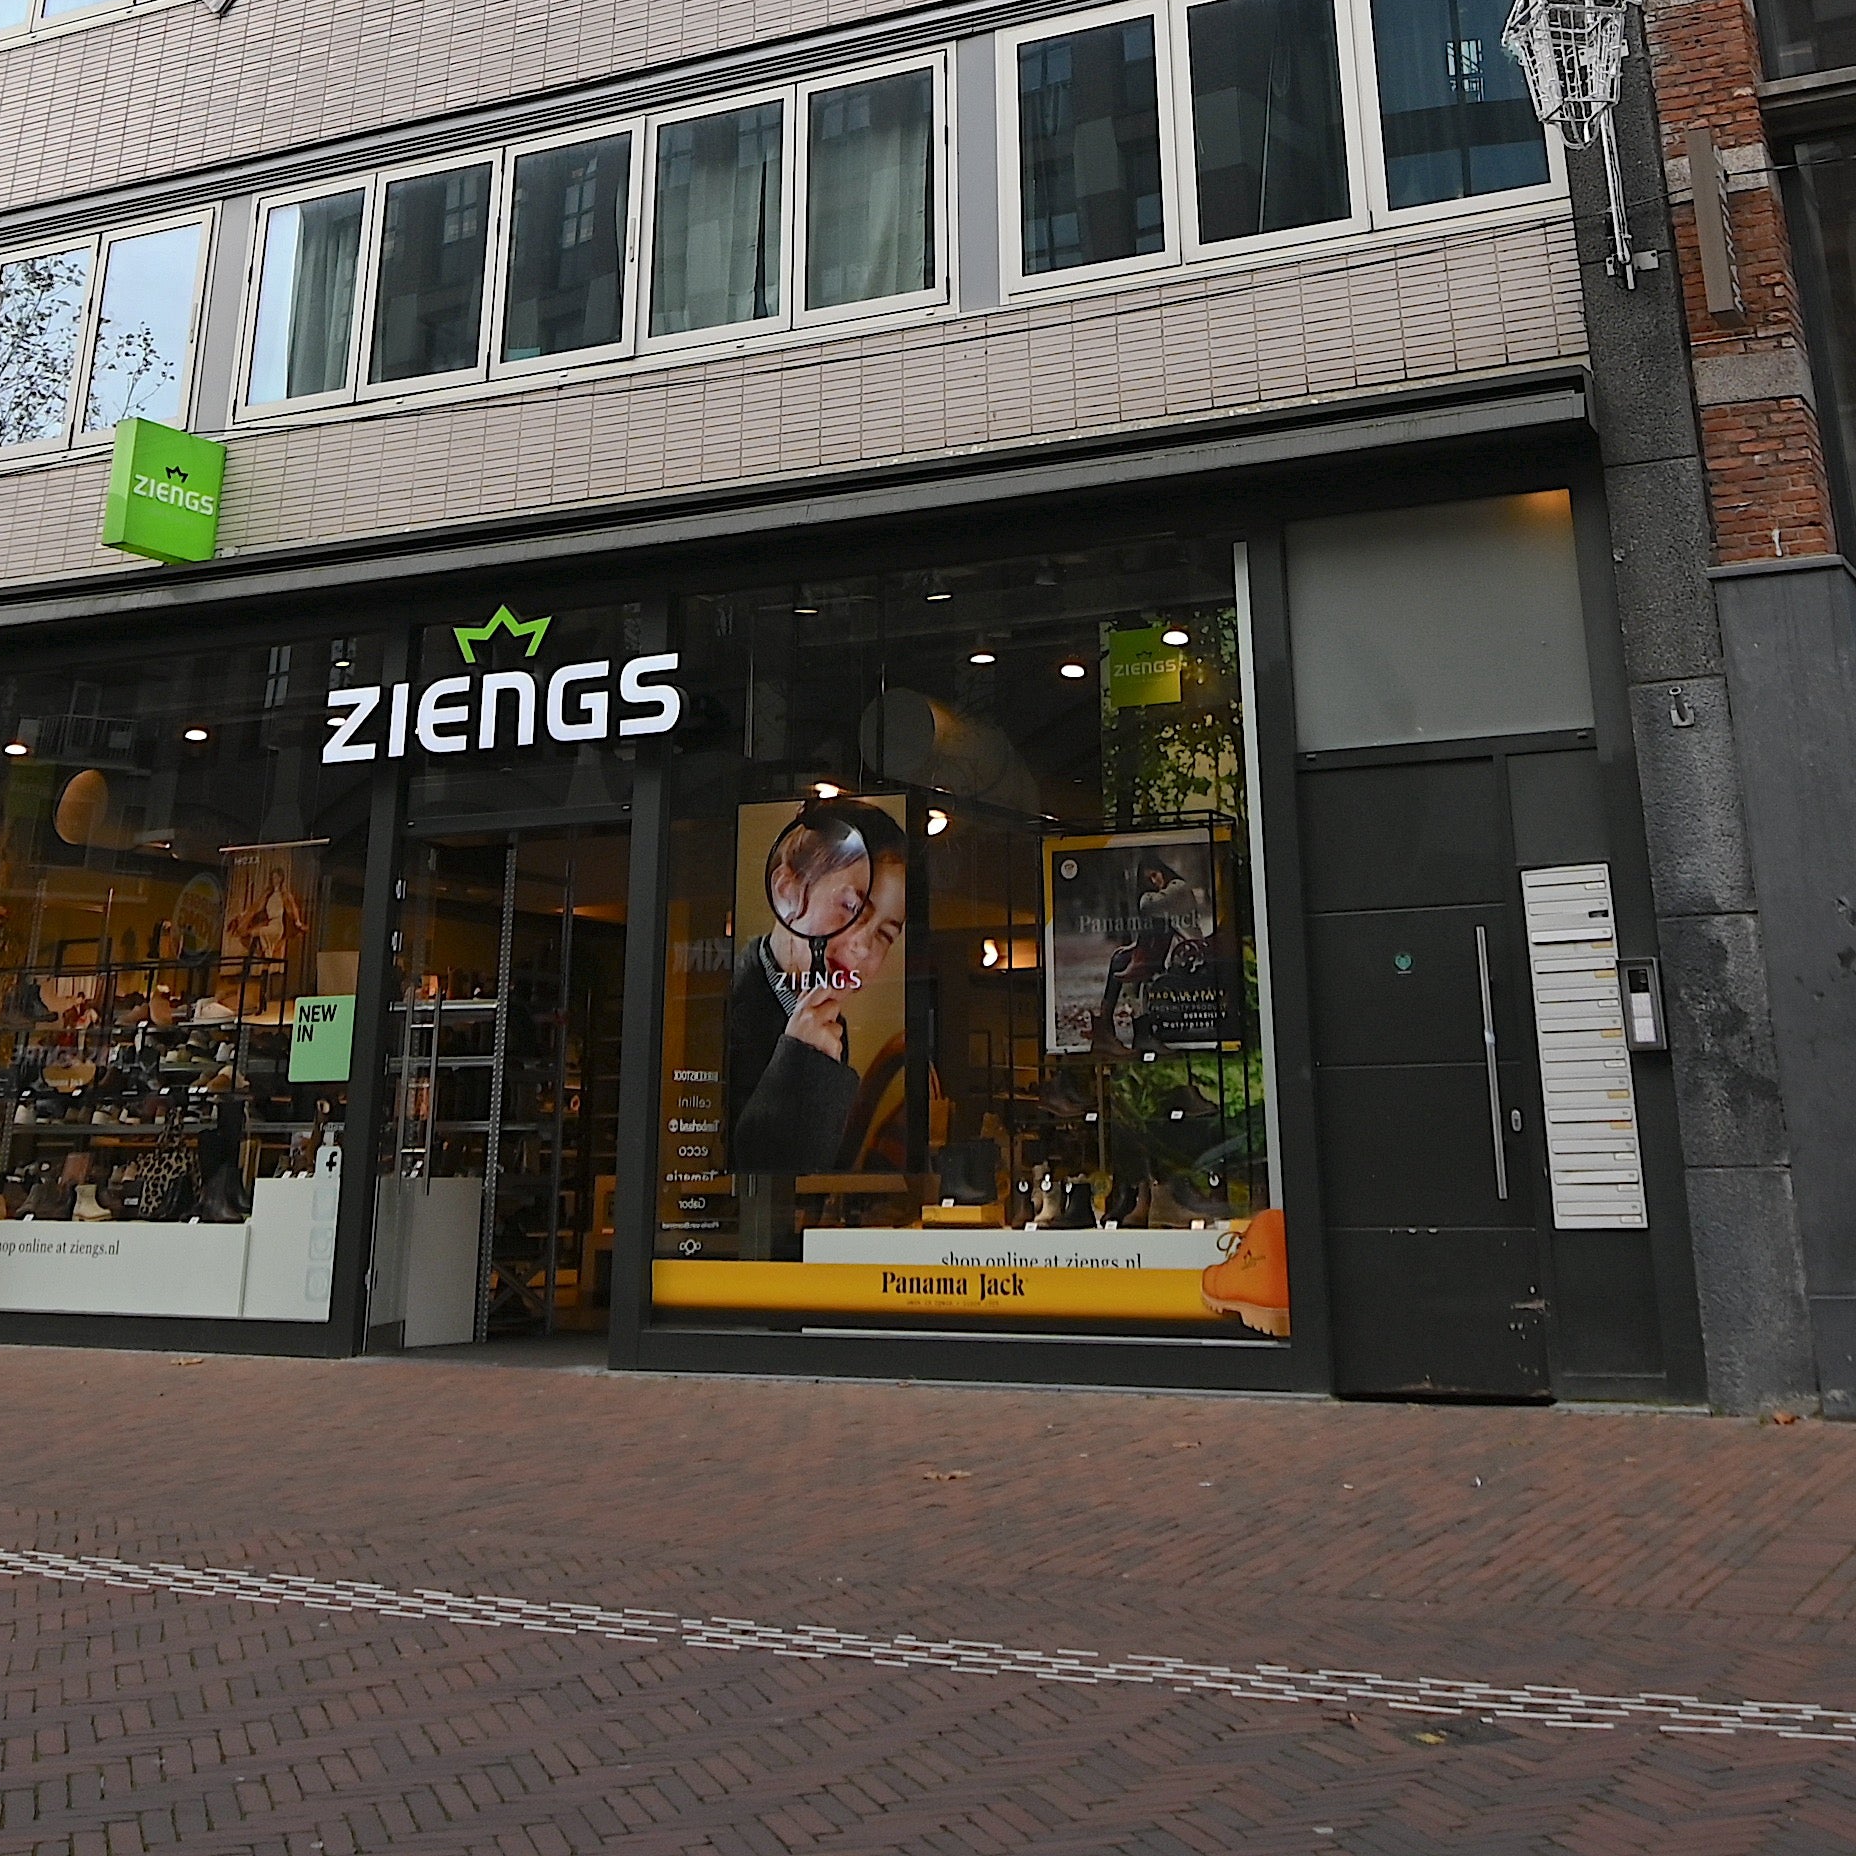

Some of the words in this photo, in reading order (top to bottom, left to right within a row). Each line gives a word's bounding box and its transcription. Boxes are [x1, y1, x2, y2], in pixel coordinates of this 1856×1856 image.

[133, 473, 215, 517] ZIENGS
[1113, 659, 1177, 677] ZIENGS
[322, 653, 681, 764] ZIENGS
[1079, 915, 1154, 933] Panama
[1164, 909, 1202, 932] Jack
[775, 969, 863, 990] ZIENGS
[298, 1003, 338, 1023] NEW
[297, 1024, 314, 1043] IN
[18, 1237, 54, 1254] online
[55, 1242, 67, 1254] at
[69, 1240, 120, 1258] ziengs.nl
[941, 1251, 981, 1267] shop
[986, 1251, 1038, 1268] online
[1044, 1253, 1059, 1268] at
[881, 1272, 968, 1296] Panama
[978, 1273, 1025, 1301] Jack
